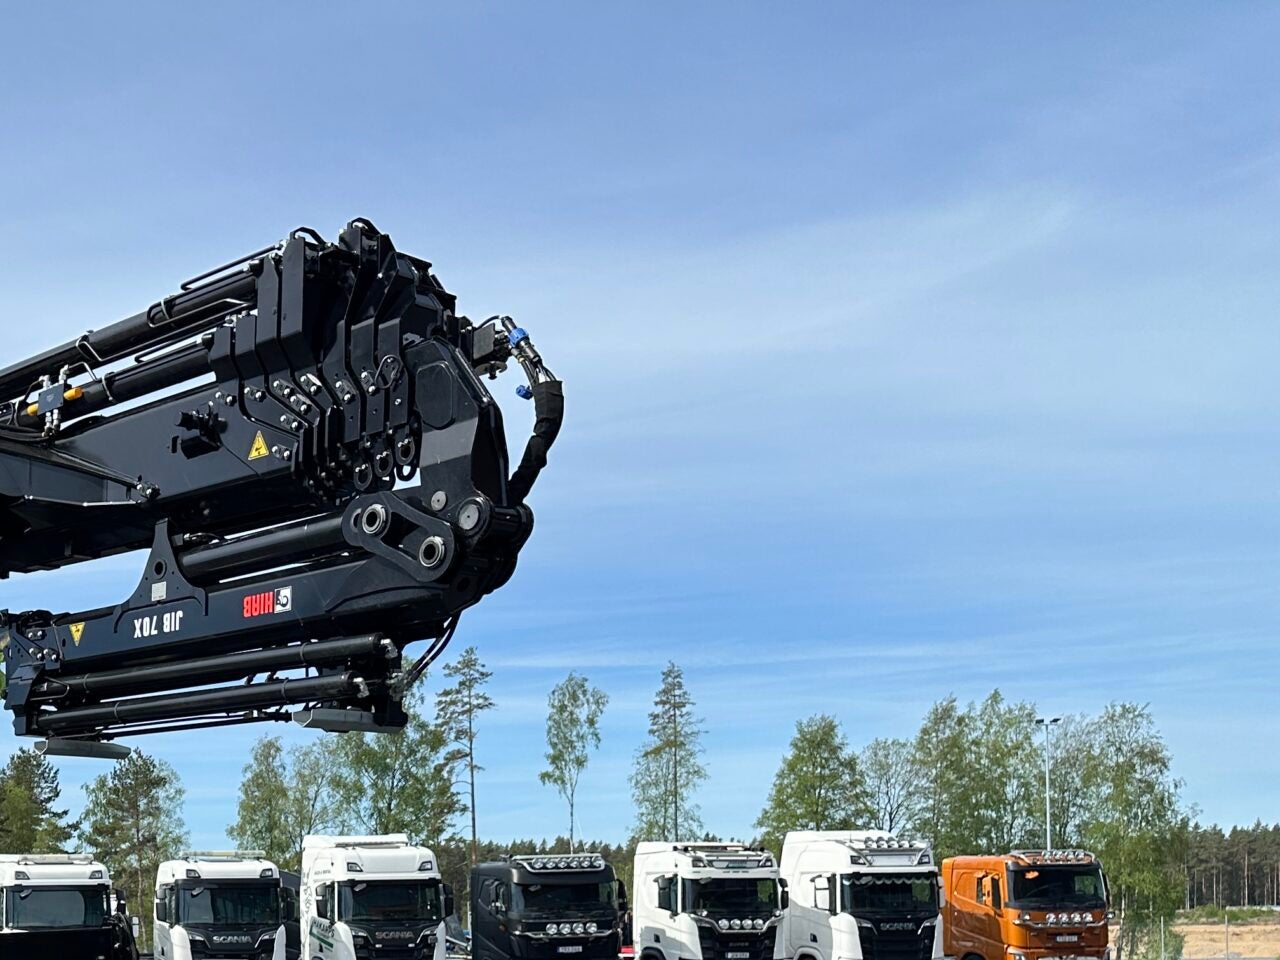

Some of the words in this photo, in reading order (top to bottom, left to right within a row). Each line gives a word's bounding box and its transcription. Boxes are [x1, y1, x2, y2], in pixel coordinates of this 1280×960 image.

[243, 591, 274, 618] HIAB
[133, 616, 158, 639] 70X
[163, 610, 184, 633] JIB
[212, 935, 252, 943] SCANIA
[375, 931, 415, 939] SCANIA
